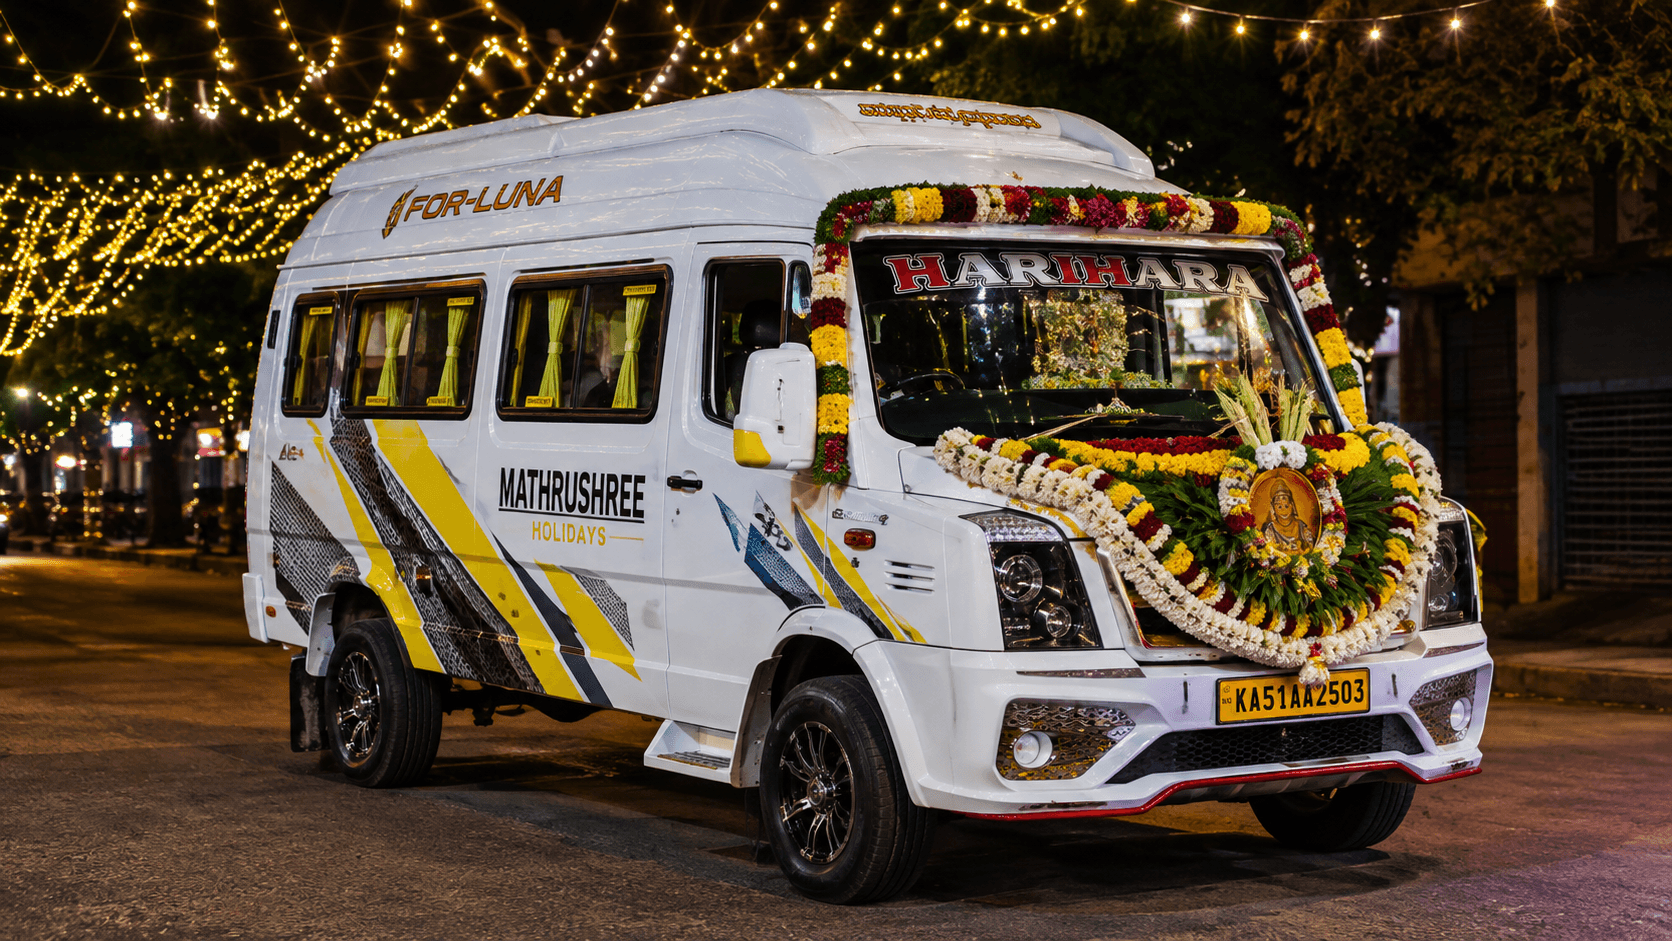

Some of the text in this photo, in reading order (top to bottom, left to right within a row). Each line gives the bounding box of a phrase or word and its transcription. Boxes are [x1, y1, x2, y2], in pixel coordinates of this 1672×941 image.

[403, 175, 564, 222] FOR-LUNA
[884, 252, 1269, 302] HARIHARA
[499, 467, 646, 518] MATHRUSHREE
[532, 521, 607, 546] HOLIDAYS
[1235, 678, 1365, 713] KA51AA2503
